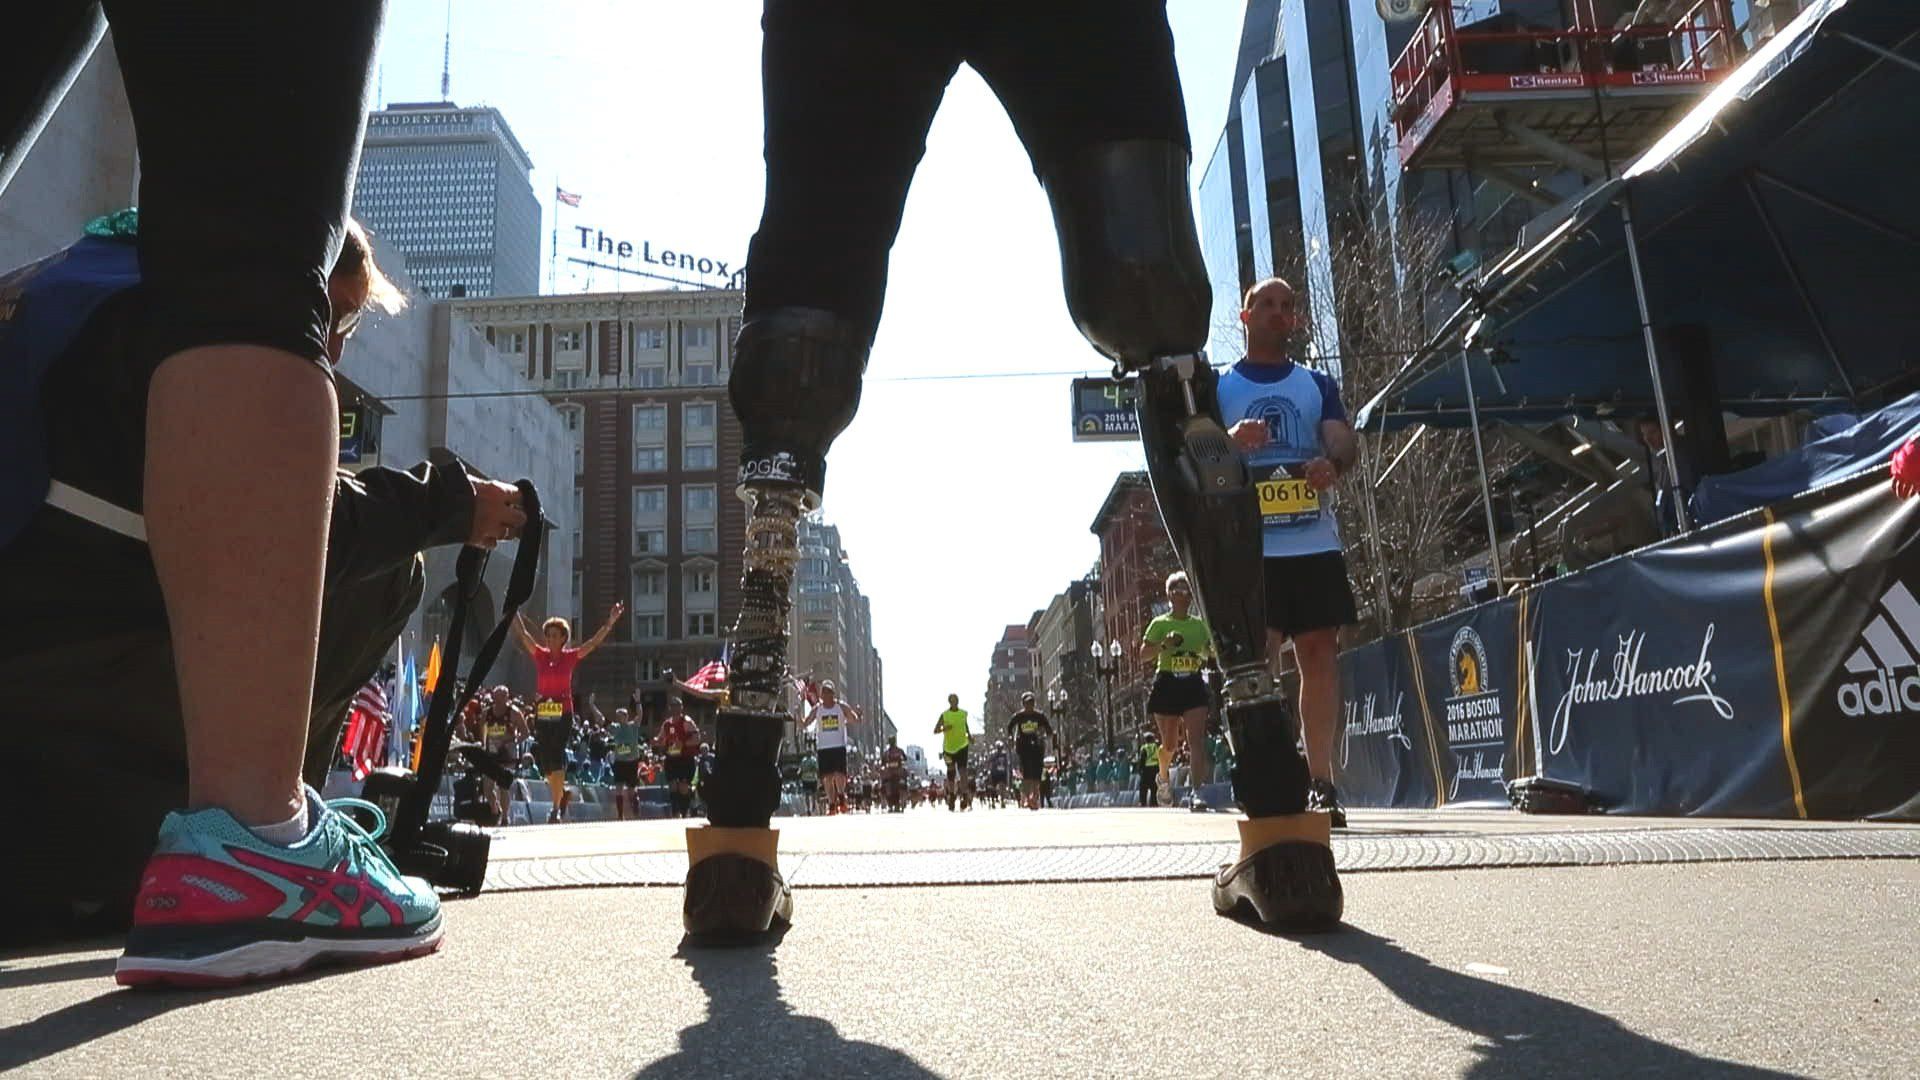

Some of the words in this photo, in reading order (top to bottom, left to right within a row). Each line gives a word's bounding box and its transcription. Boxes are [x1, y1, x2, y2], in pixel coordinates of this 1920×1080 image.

[371, 114, 468, 125] PRUDENTIAL
[575, 225, 633, 258] The
[644, 240, 729, 278] Lenox
[1104, 413, 1126, 422] 2016
[1550, 647, 1609, 755] John
[1608, 622, 1734, 720] Hancock
[1447, 702, 1465, 721] 2016
[1466, 697, 1500, 718] BOSTON
[1448, 719, 1503, 742] MARATHON
